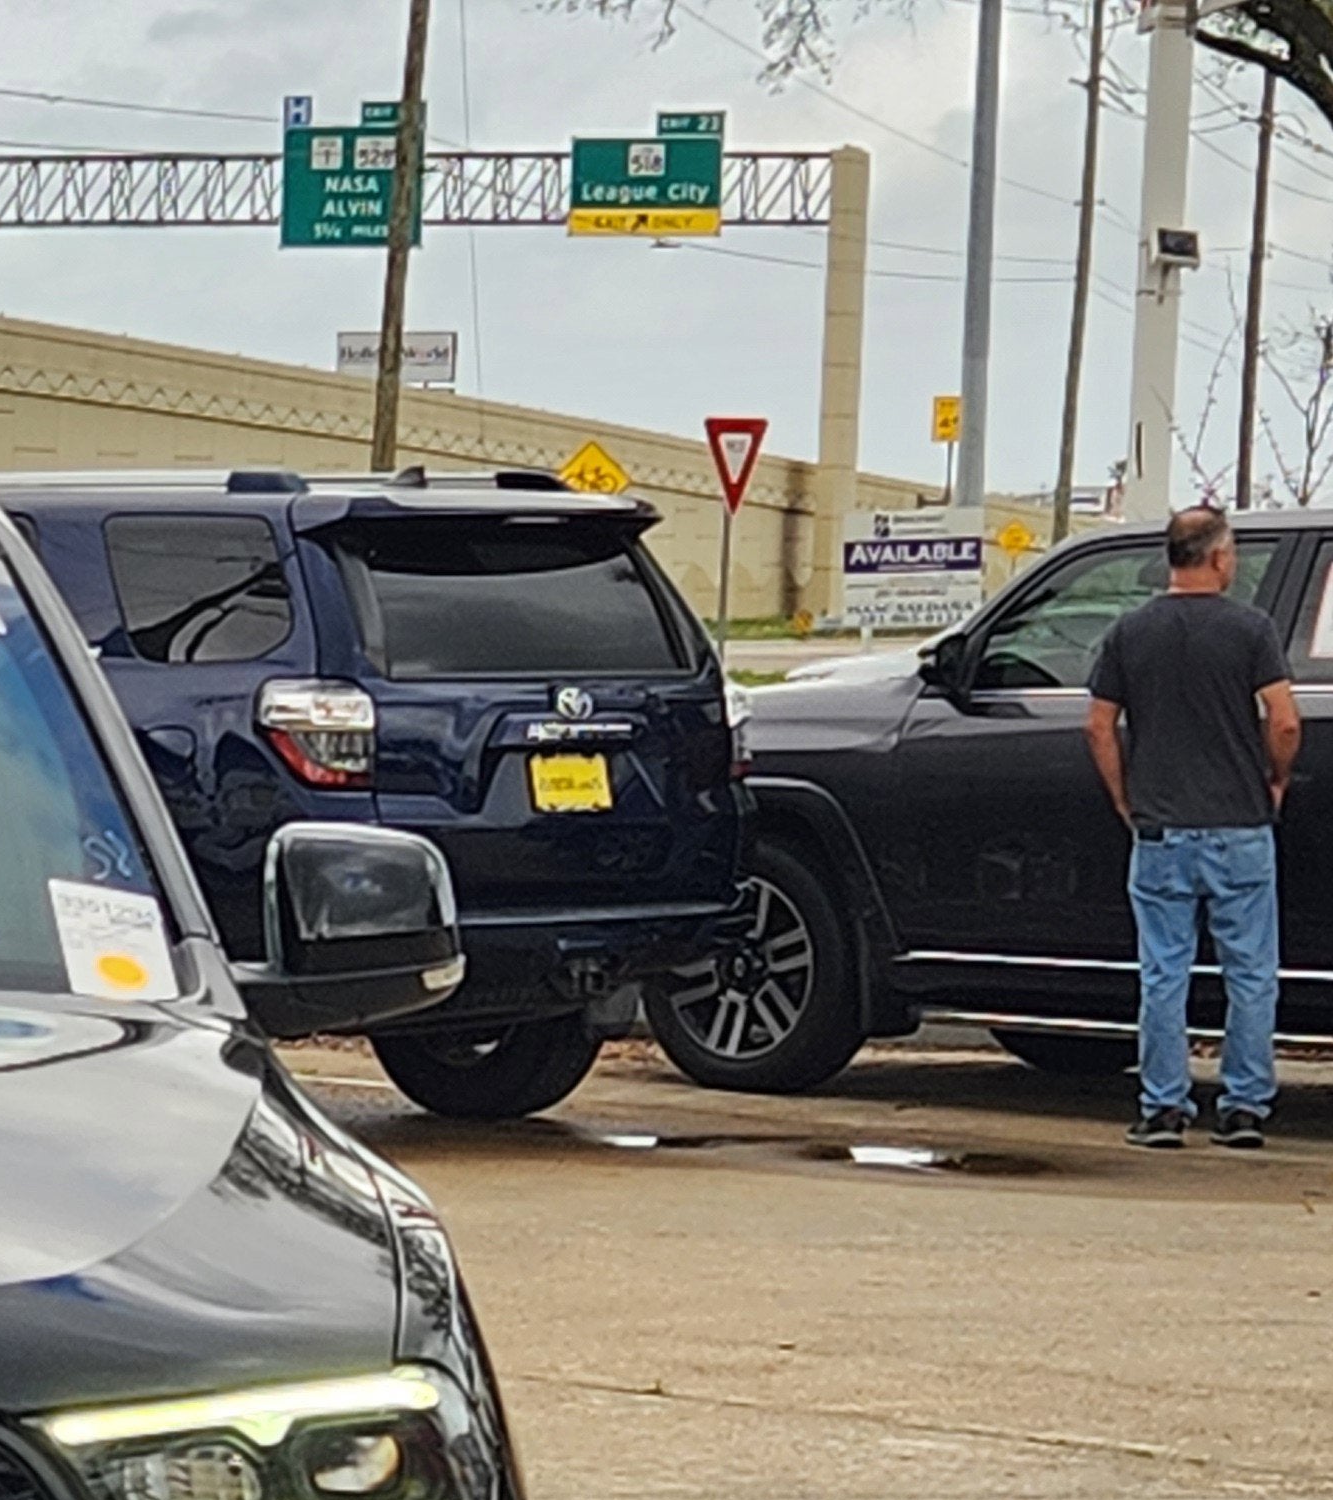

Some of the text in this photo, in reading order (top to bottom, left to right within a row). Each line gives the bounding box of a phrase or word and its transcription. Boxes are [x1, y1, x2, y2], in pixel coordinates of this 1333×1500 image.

[324, 176, 380, 193] NASA
[581, 182, 710, 204] League City
[322, 199, 383, 217] ALVIN
[849, 541, 977, 566] AVAILABLE
